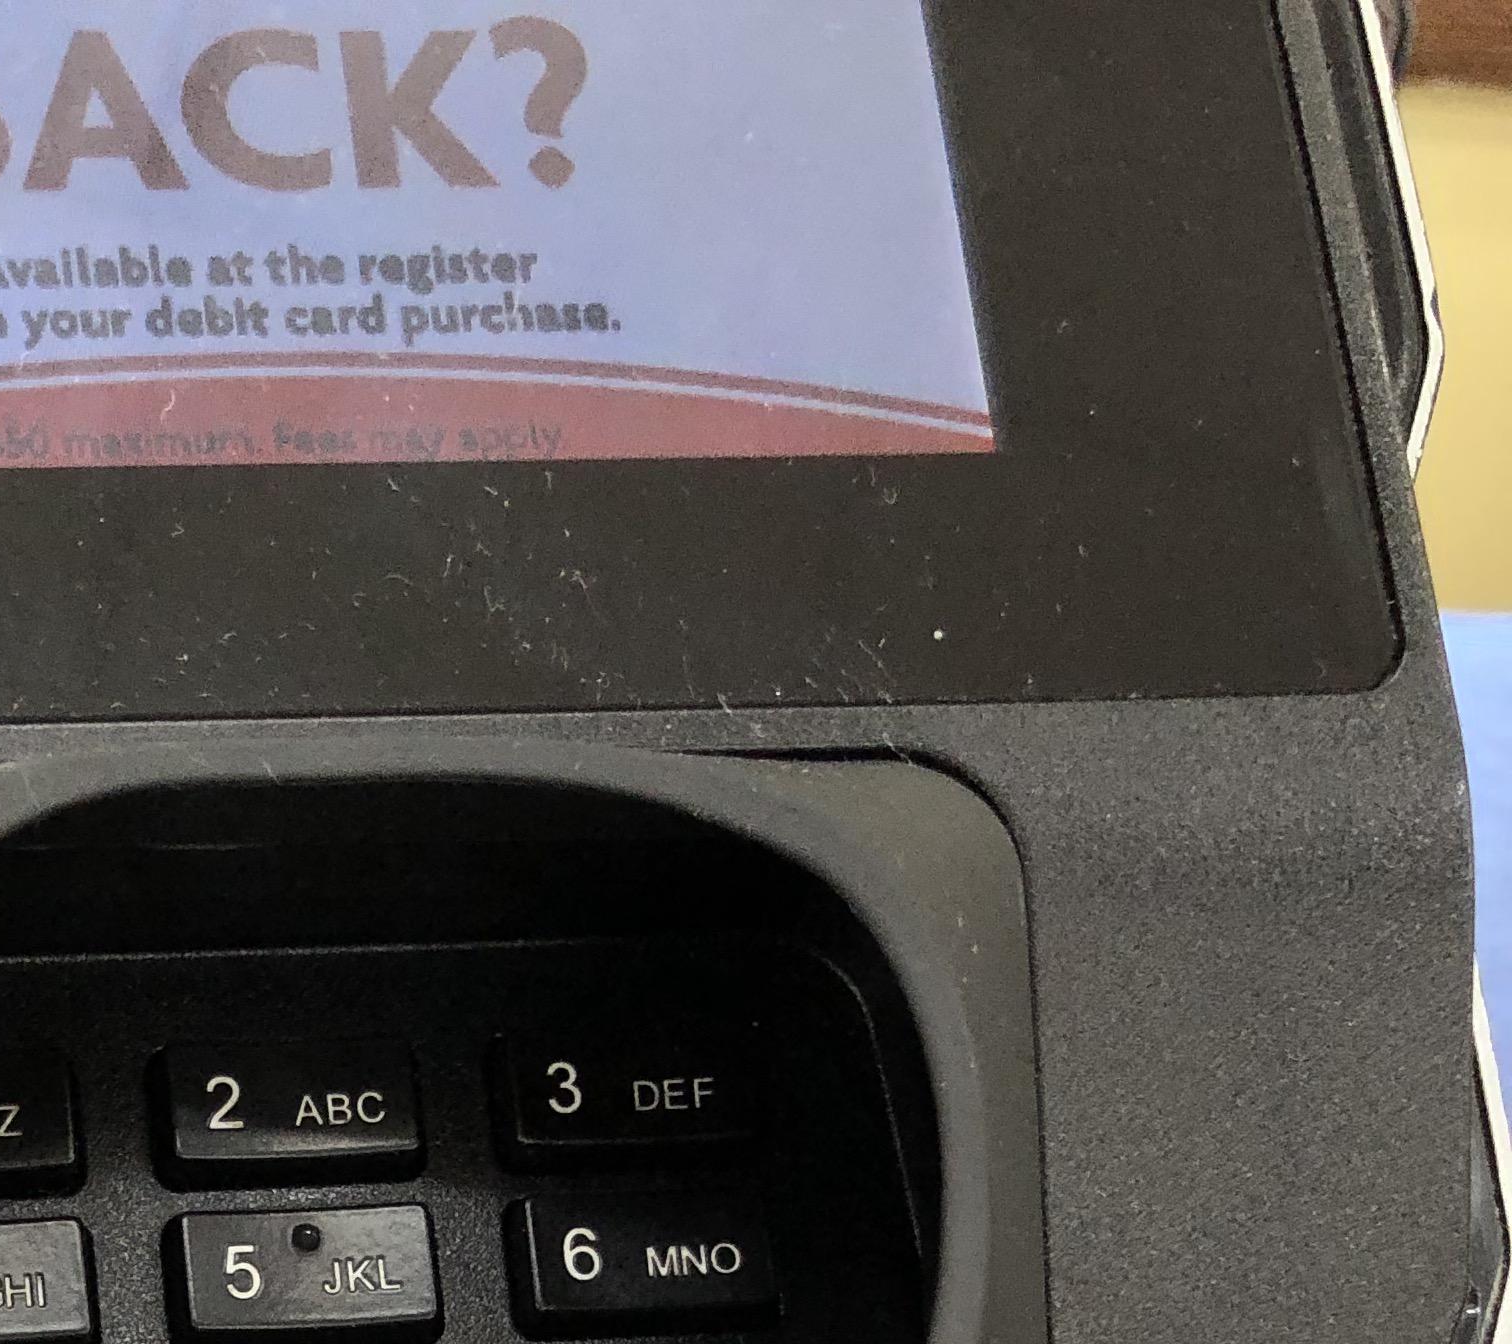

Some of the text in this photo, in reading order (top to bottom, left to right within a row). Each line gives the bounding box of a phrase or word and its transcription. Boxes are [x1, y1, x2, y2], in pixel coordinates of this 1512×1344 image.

[210, 250, 252, 287] at
[264, 246, 346, 287] the
[358, 246, 538, 296] register
[22, 306, 133, 350] your
[145, 296, 269, 338] debit
[284, 293, 386, 336] card
[402, 292, 622, 347] purchase.
[369, 425, 445, 460] may
[205, 1076, 387, 1131] 2 ABC
[545, 1062, 716, 1114] 3 DEF
[224, 1245, 403, 1300] 5 JKL
[563, 1229, 743, 1283] 6 MNO
